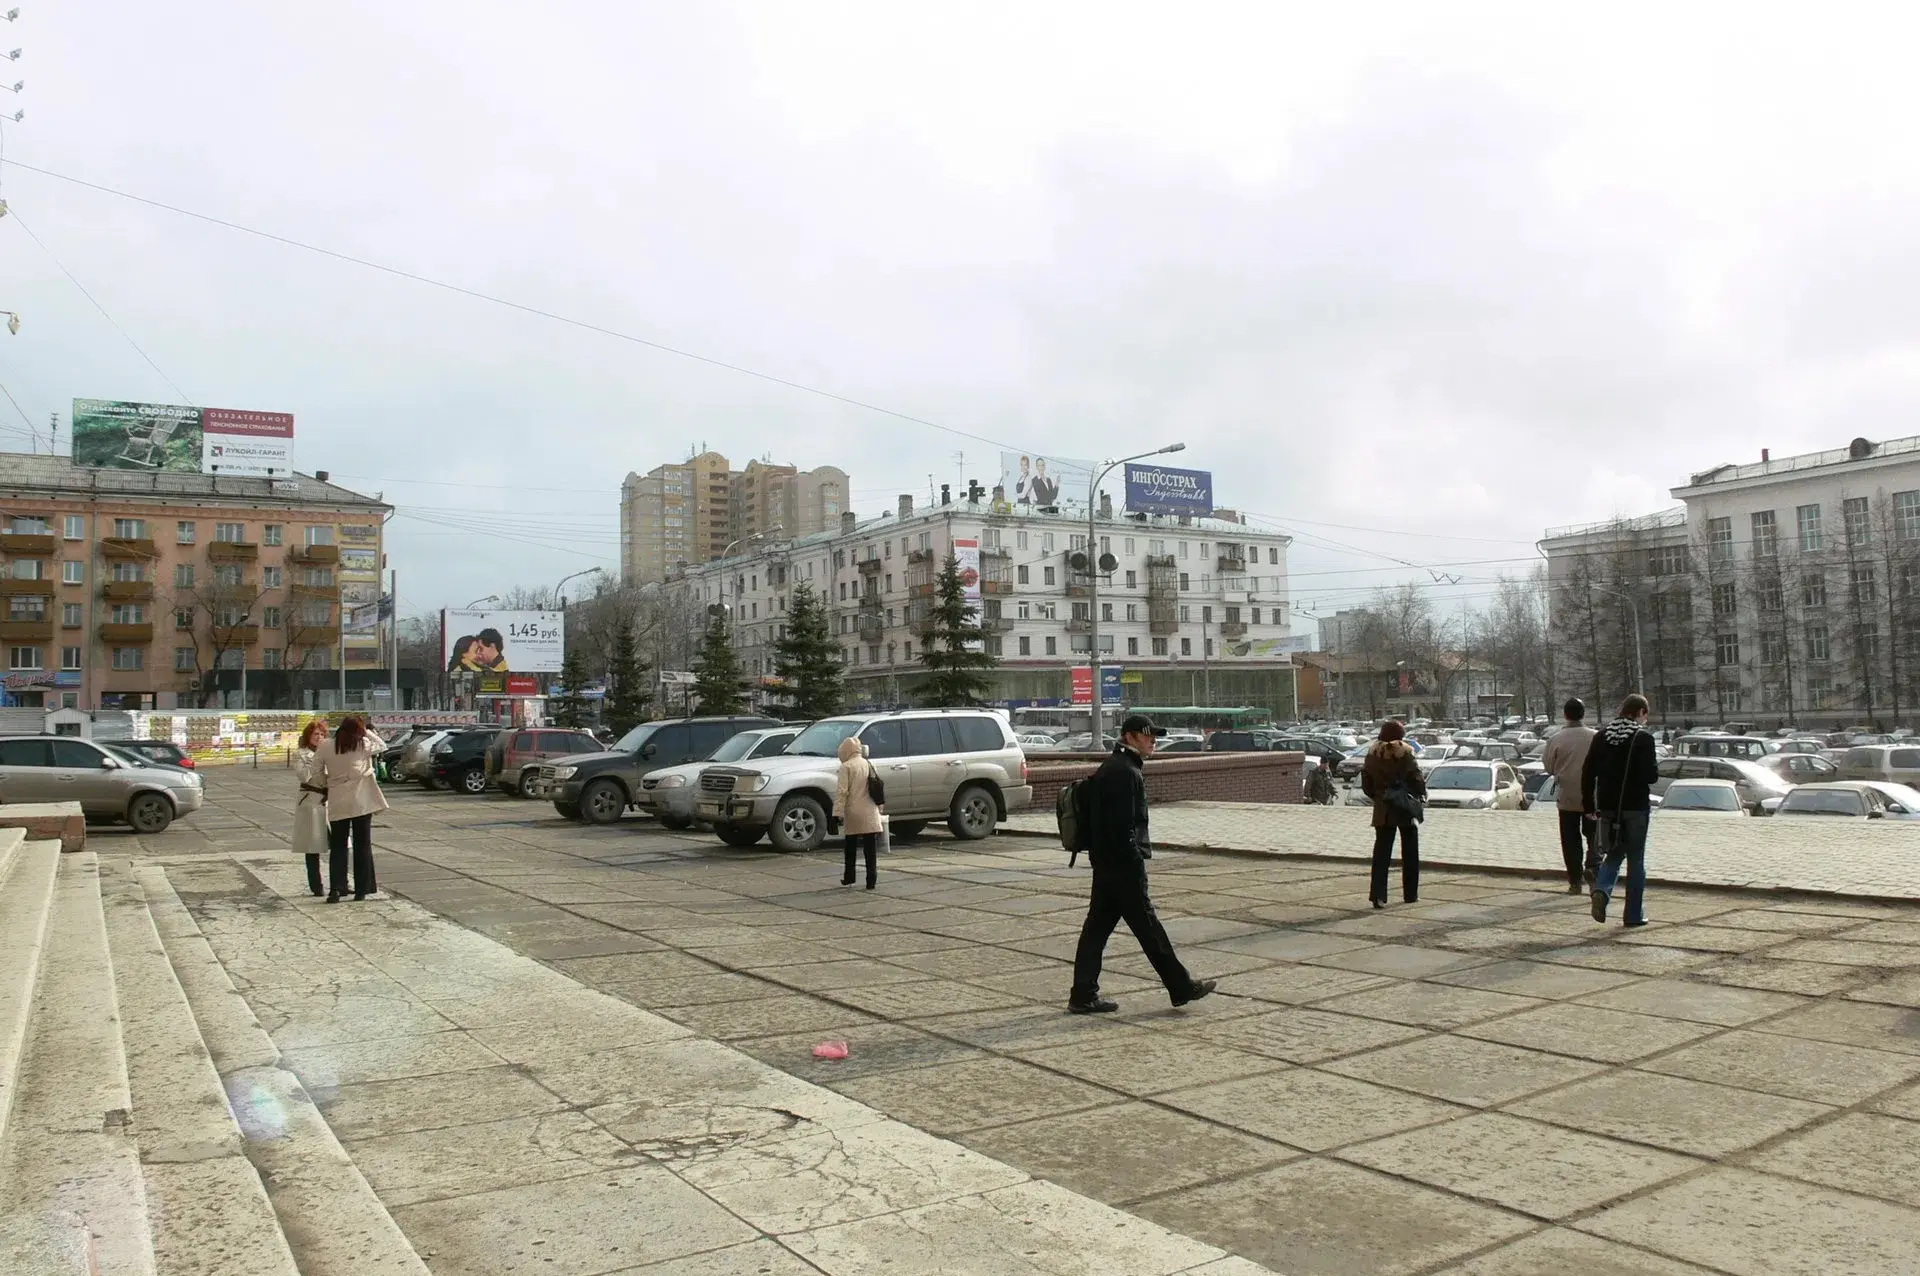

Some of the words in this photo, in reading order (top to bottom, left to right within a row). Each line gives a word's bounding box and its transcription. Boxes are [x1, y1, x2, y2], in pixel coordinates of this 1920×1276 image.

[138, 406, 199, 418] СВОБОДНО
[210, 412, 287, 423] ОБЯЗАТЕЛЬНОЕ
[225, 447, 286, 457] ЛУКОЙЛ-ГАРАНТ
[1132, 469, 1198, 489] ИНГОССТРАХ
[509, 623, 538, 638] 1,45
[541, 628, 560, 639] руб.
